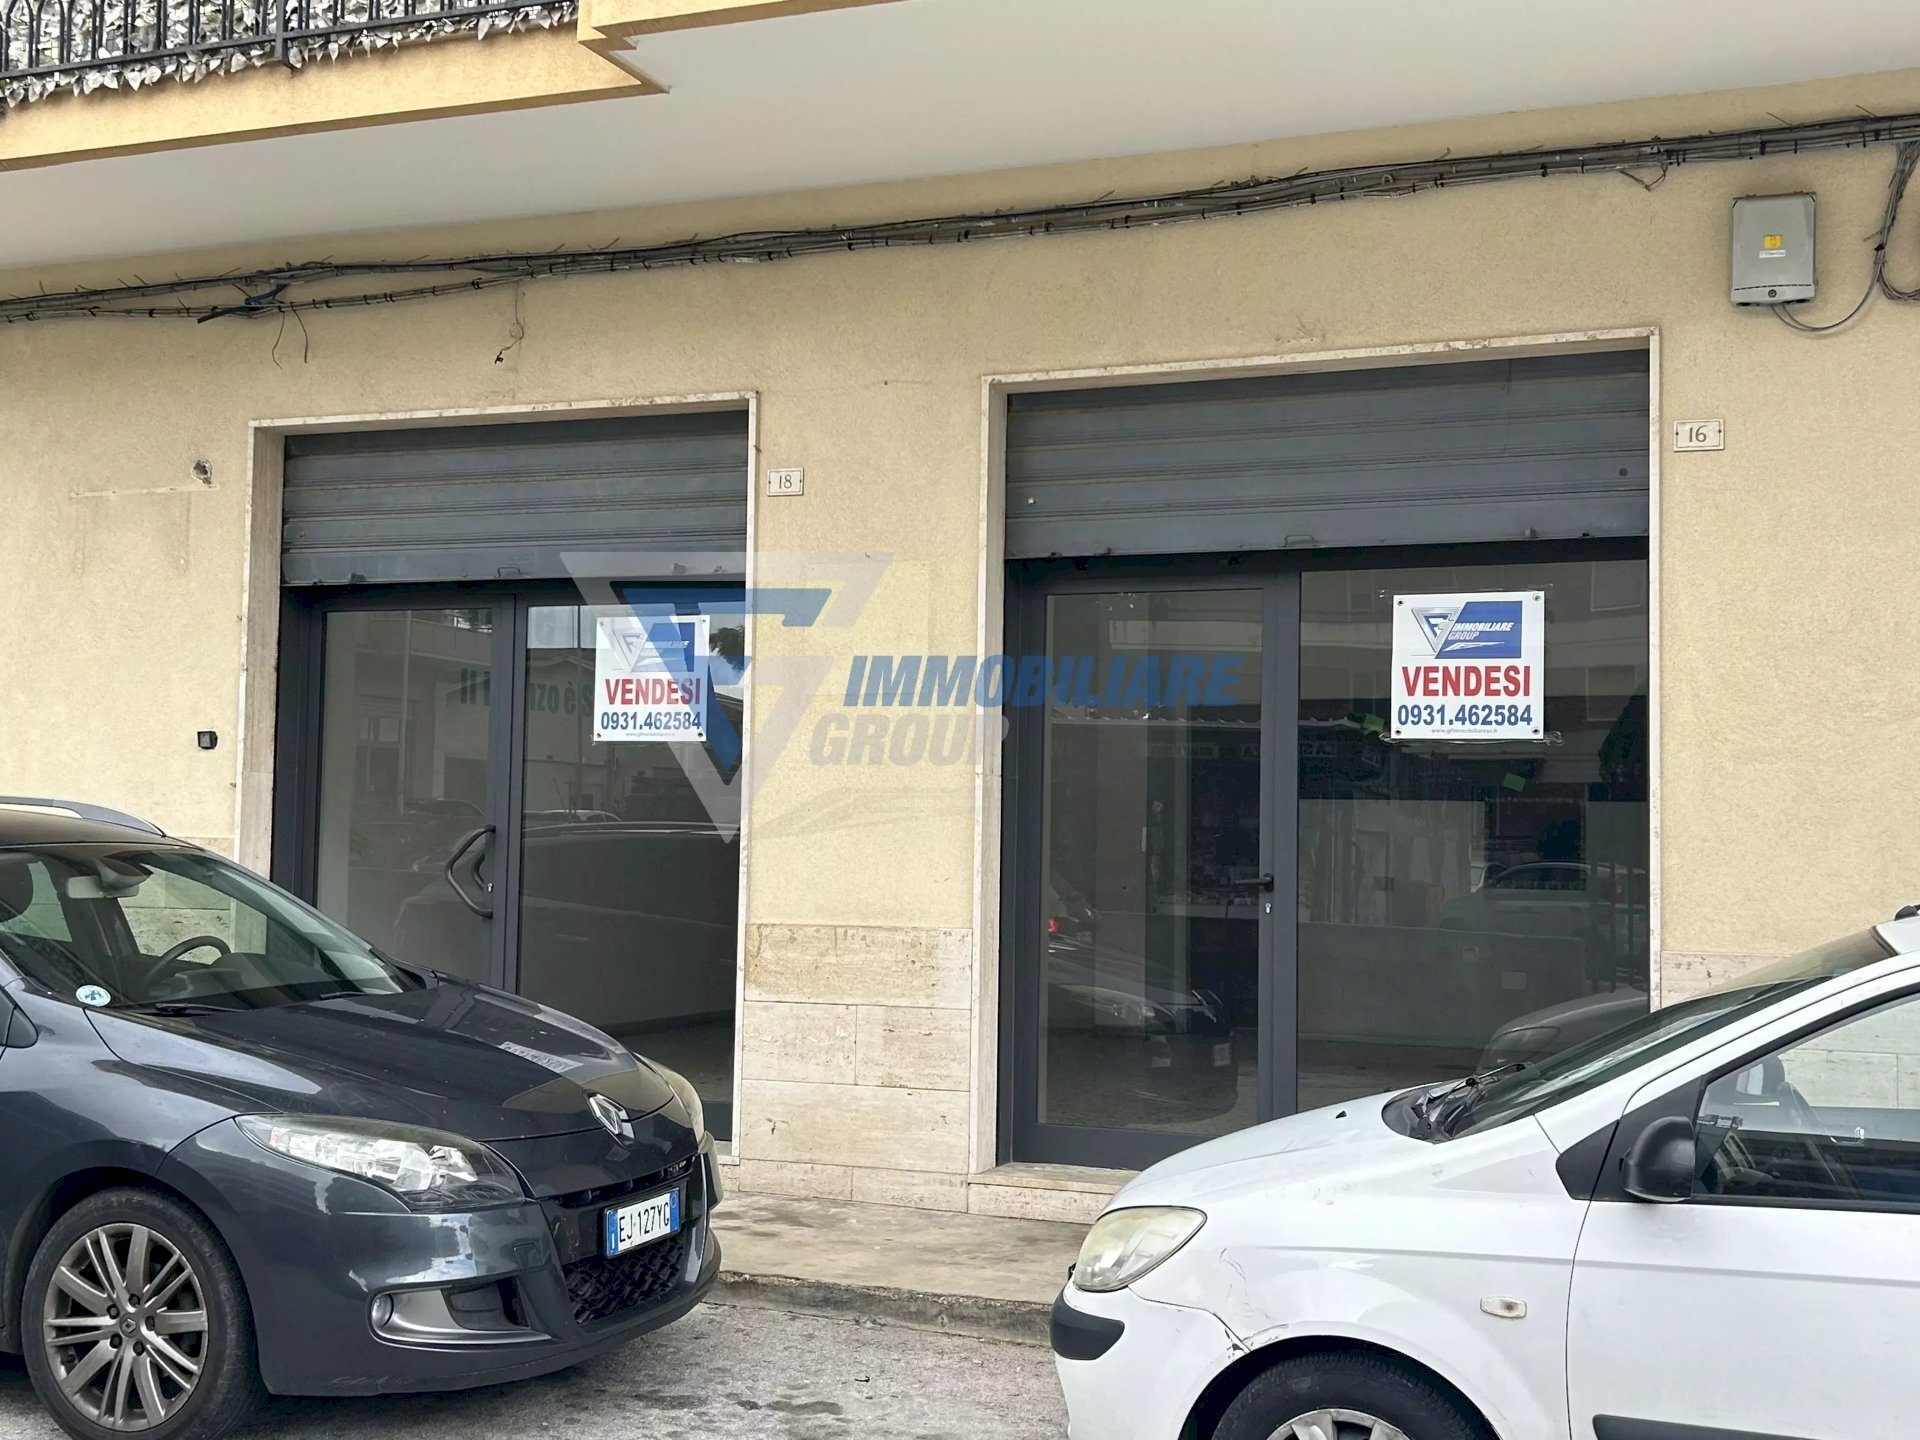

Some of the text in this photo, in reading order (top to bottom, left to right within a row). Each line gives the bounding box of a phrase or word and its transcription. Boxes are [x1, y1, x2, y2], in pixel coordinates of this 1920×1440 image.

[1689, 425, 1708, 443] 16
[778, 474, 793, 489] 18
[1452, 622, 1514, 632] IMMOBILIARE
[1402, 664, 1531, 697] VENDESI
[604, 678, 701, 705] VENDESI
[600, 711, 702, 730] 0931.462584
[1397, 704, 1533, 727] 0931.462584
